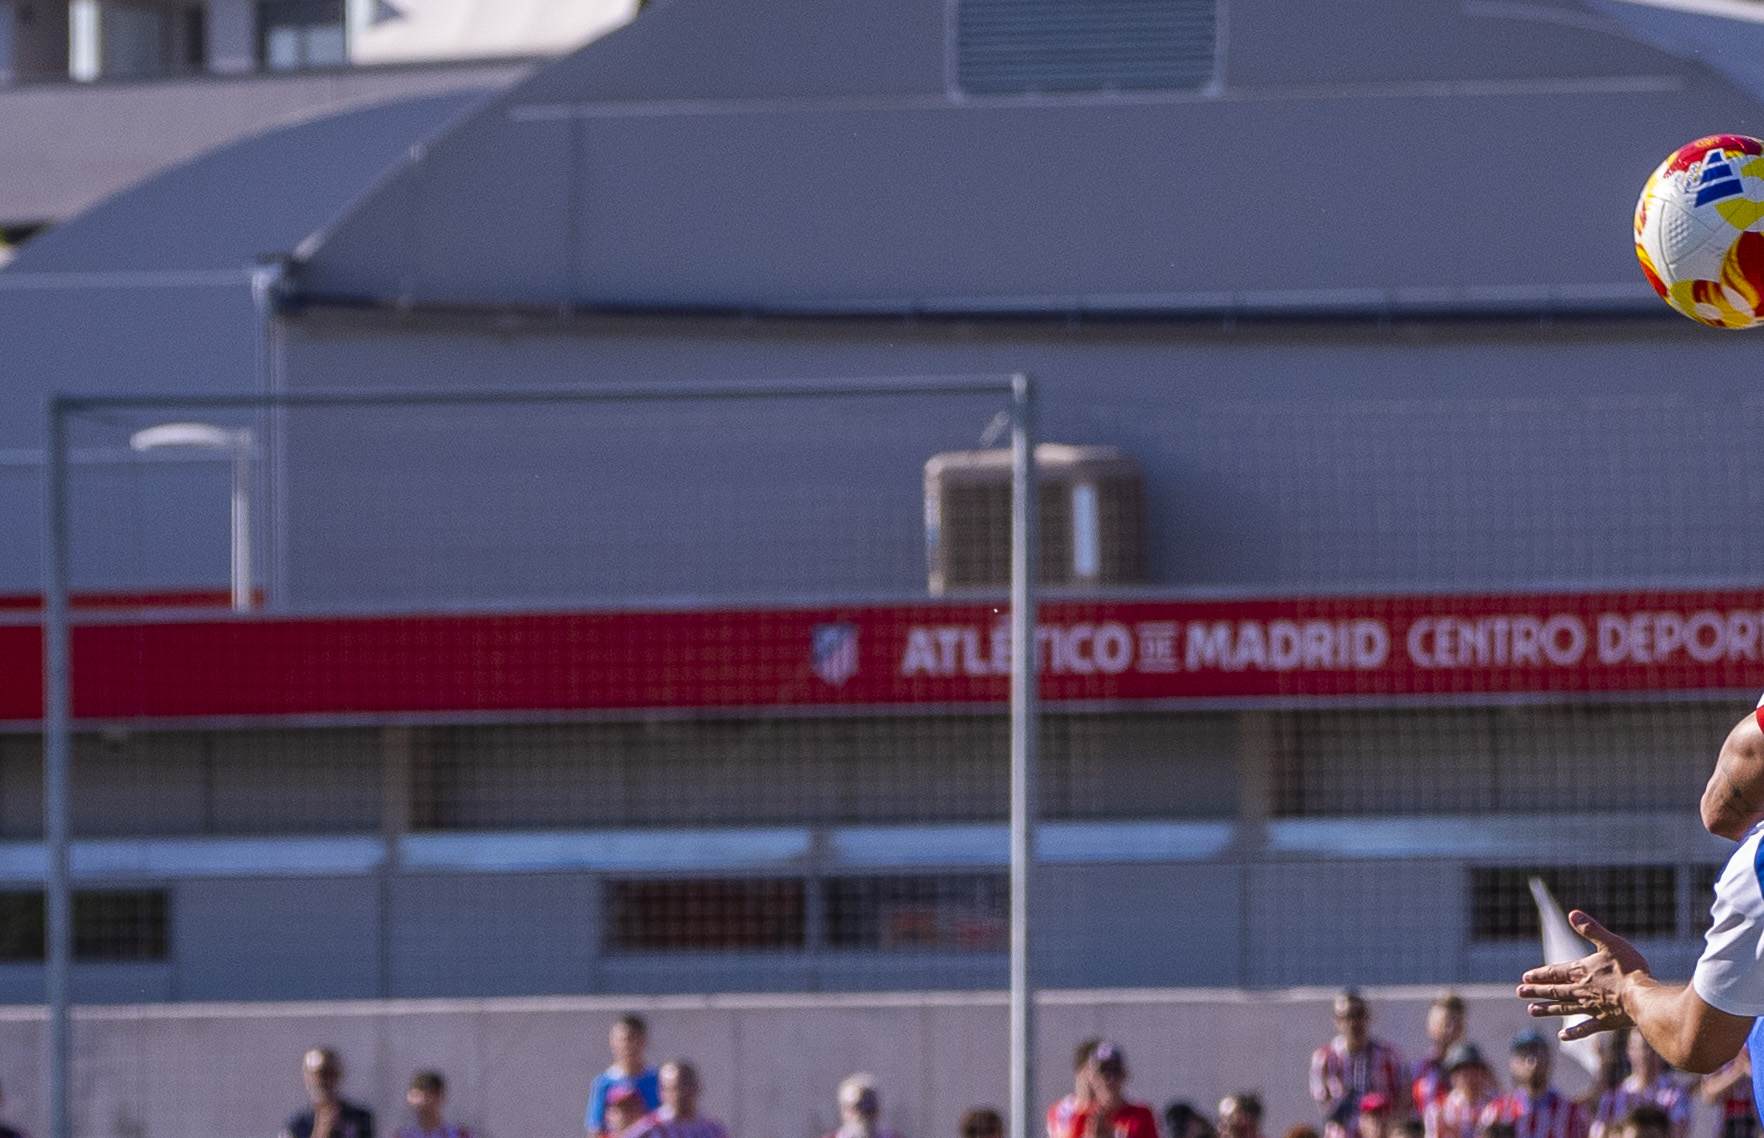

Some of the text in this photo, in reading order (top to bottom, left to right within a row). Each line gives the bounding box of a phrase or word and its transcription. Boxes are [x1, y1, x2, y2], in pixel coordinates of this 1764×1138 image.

[902, 613, 1133, 675] ATLÉICO
[1185, 619, 1390, 671] MADRID
[1407, 616, 1587, 668] CENTRO
